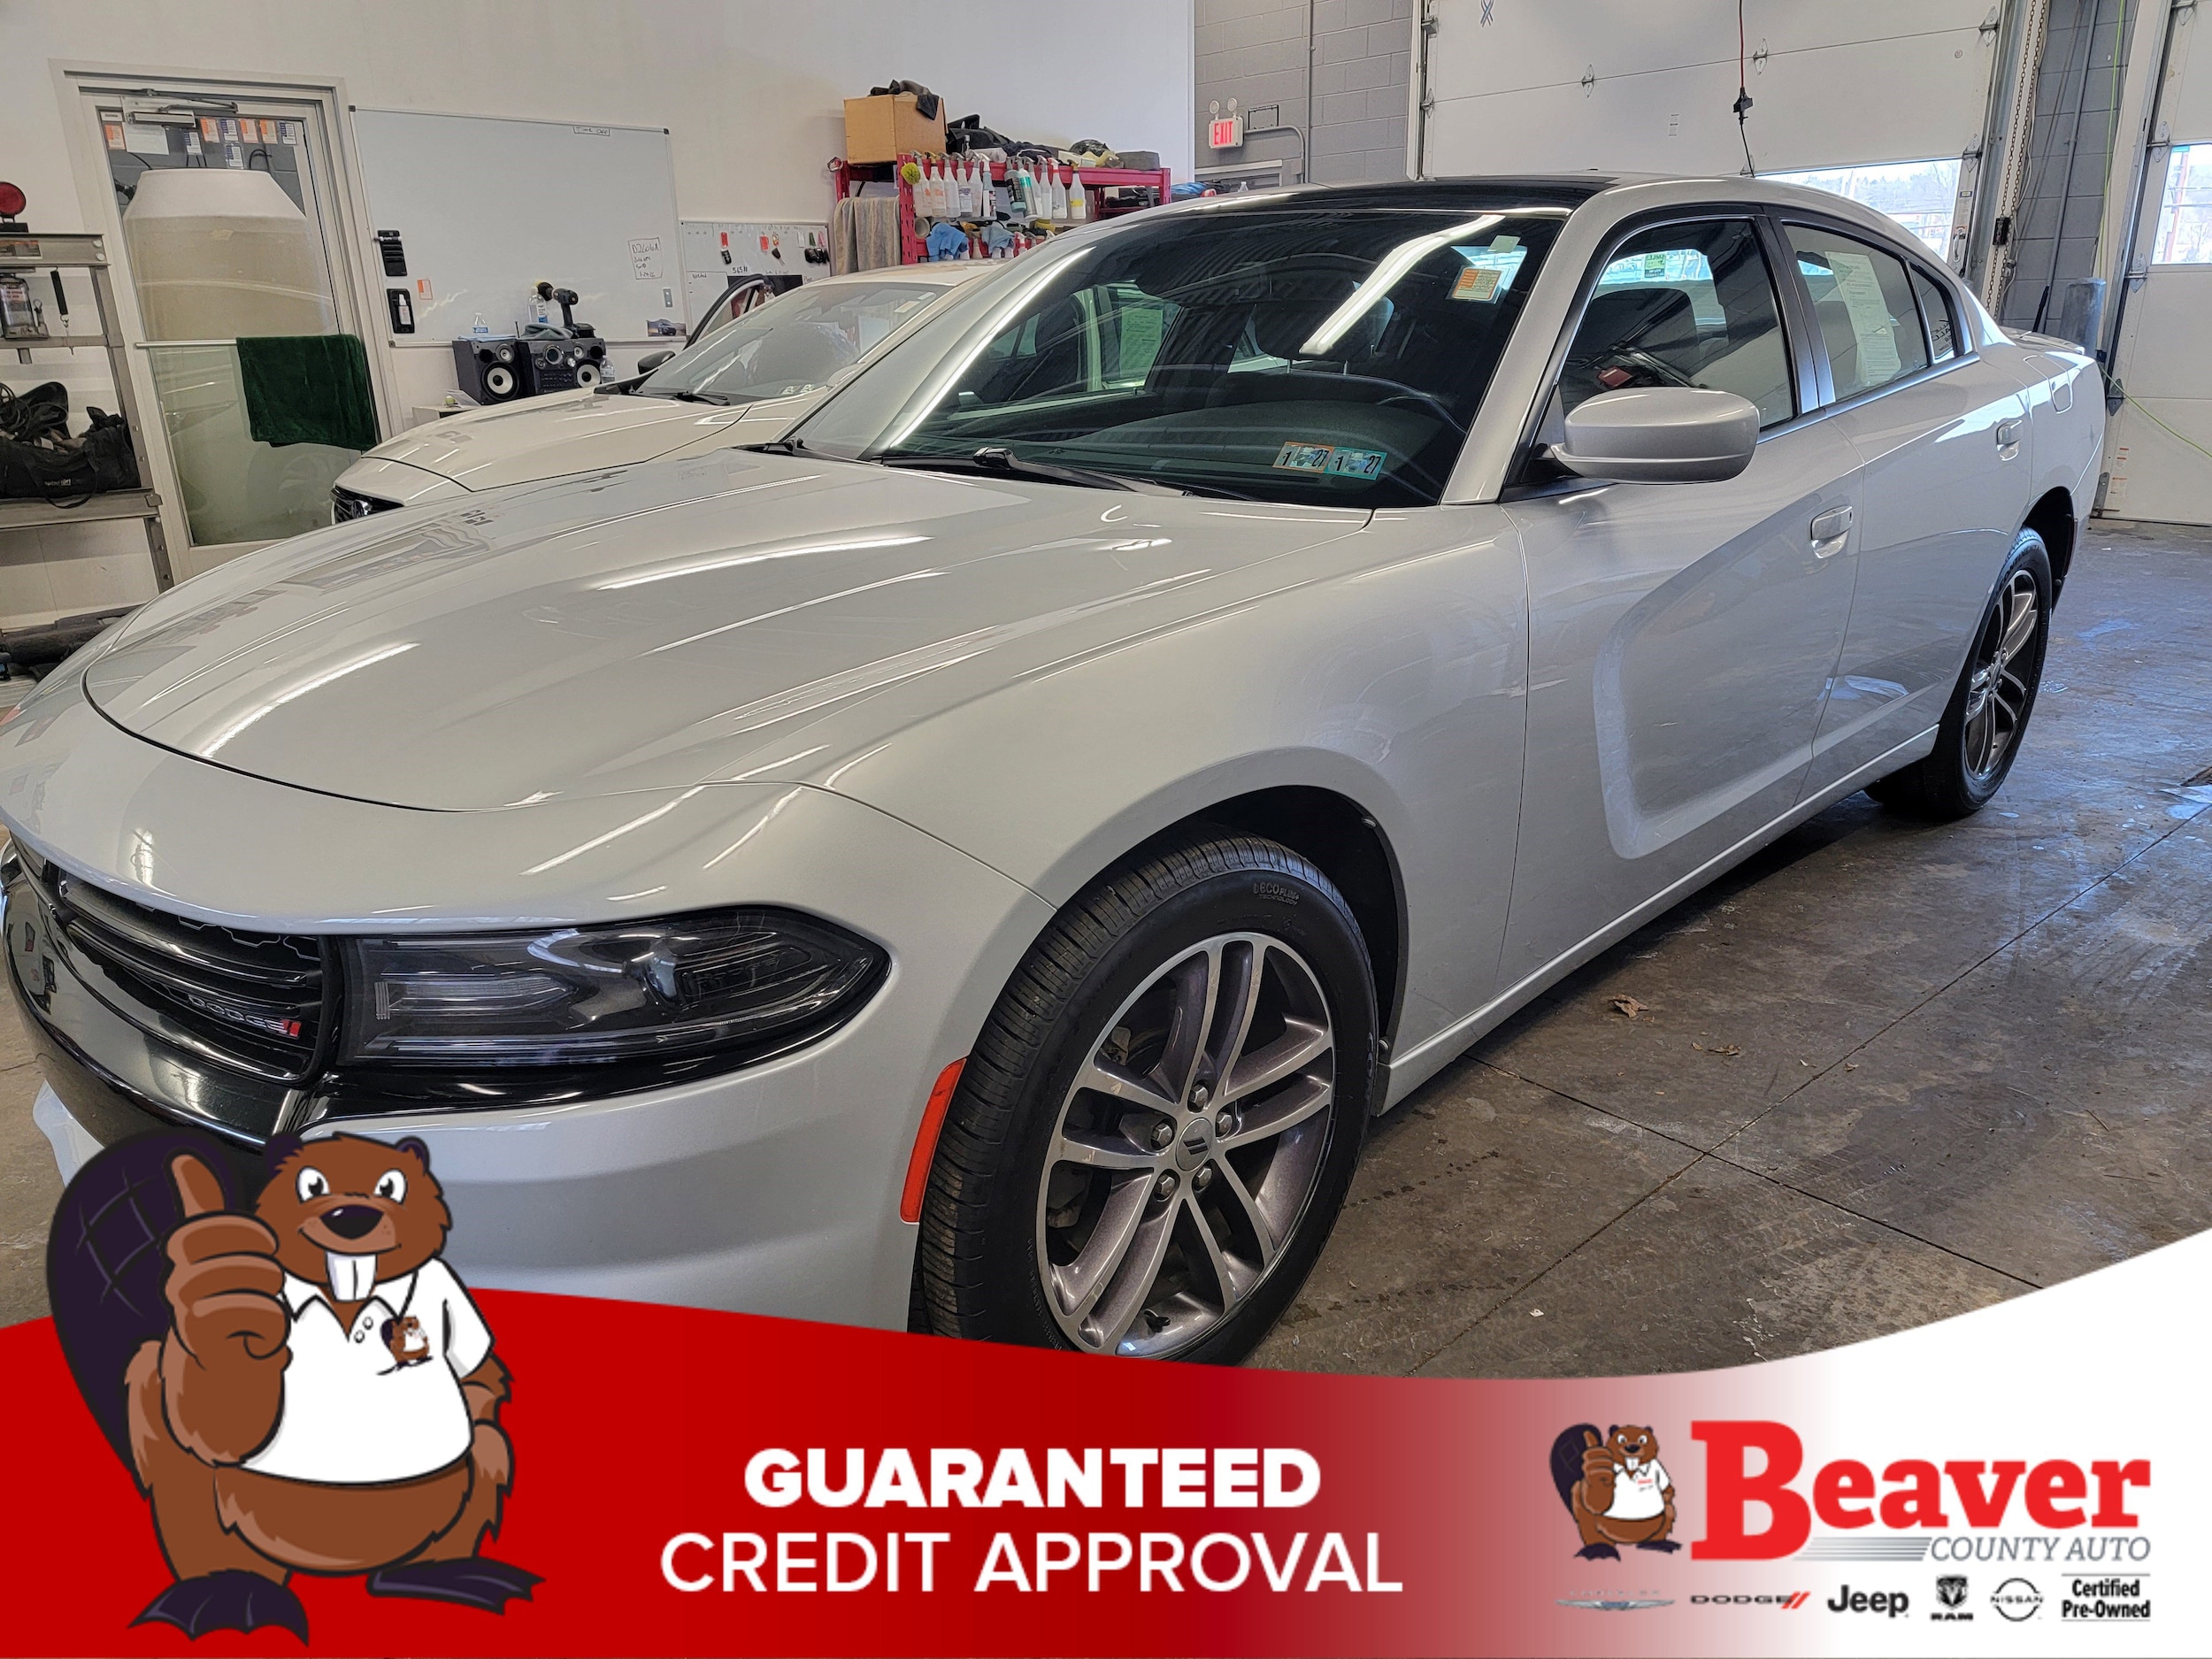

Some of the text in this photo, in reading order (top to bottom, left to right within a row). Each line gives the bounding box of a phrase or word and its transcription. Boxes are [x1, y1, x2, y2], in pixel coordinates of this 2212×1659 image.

[1214, 121, 1233, 145] EXIT
[1311, 449, 1330, 468] 27
[1363, 455, 1381, 474] 27
[1259, 894, 1298, 906] TECHNOLOGY
[187, 994, 288, 1034] DODGE
